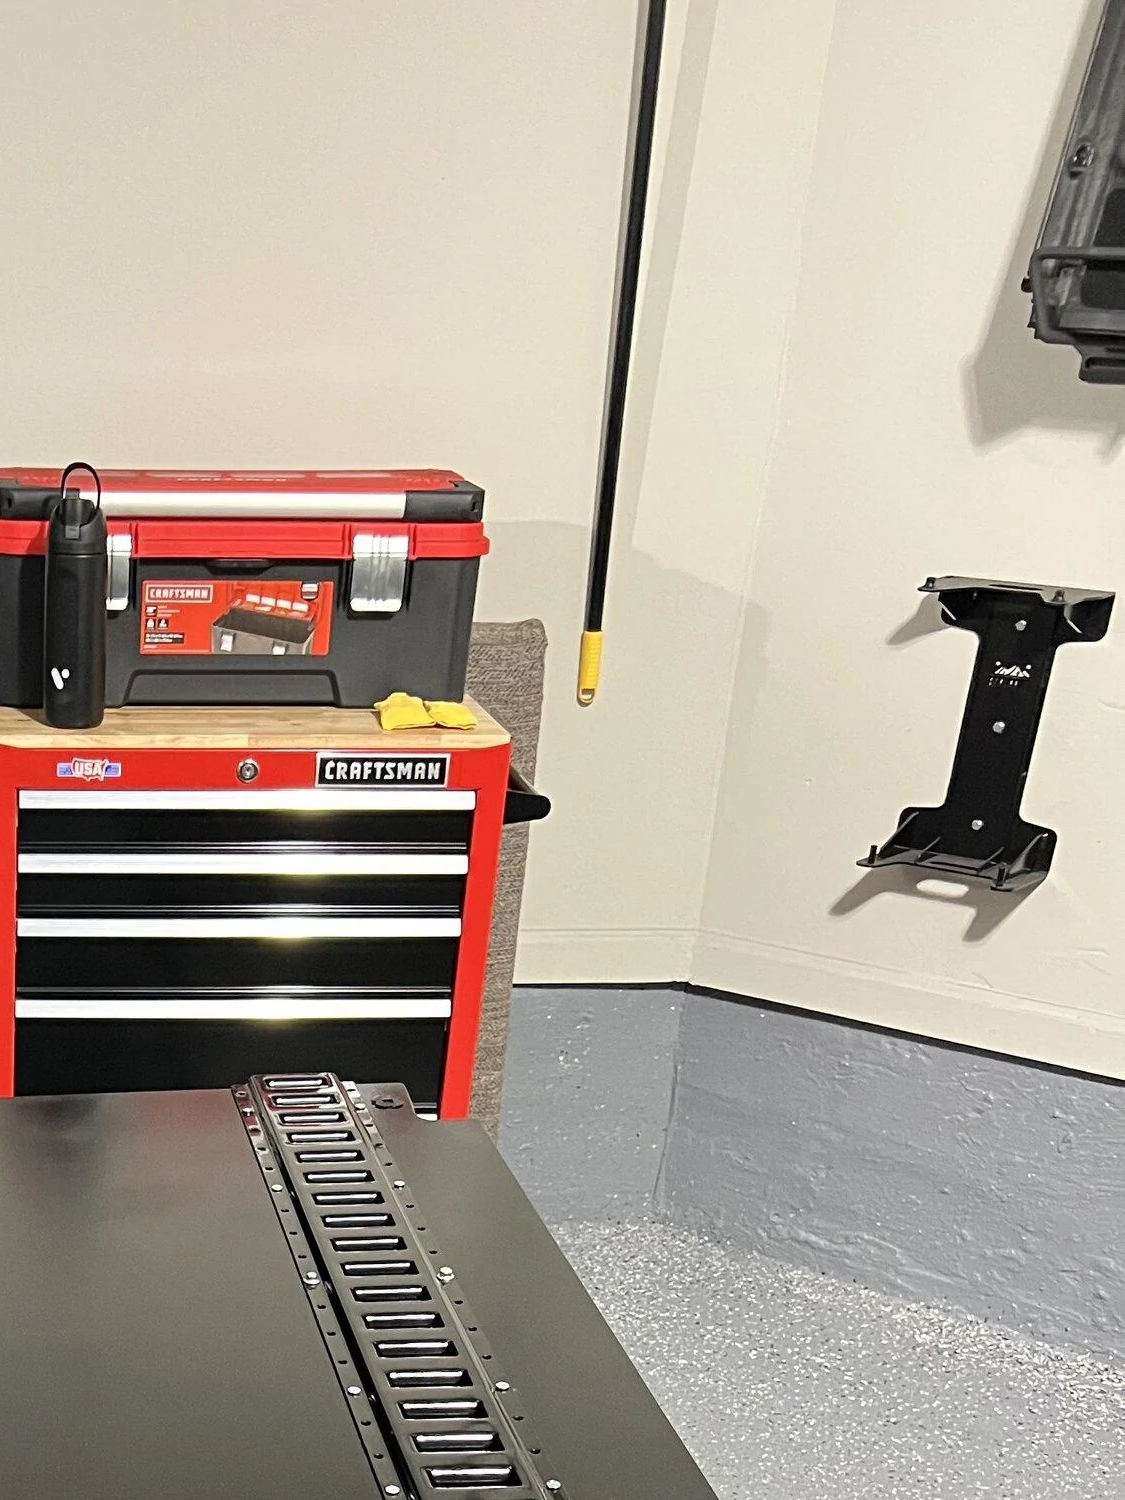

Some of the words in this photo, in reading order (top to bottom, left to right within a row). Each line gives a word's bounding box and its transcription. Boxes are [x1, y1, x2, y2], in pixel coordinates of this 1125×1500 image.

[149, 588, 209, 599] CRAFTSMAN
[75, 761, 103, 776] USA
[324, 760, 441, 780] CRAFTSMAN
